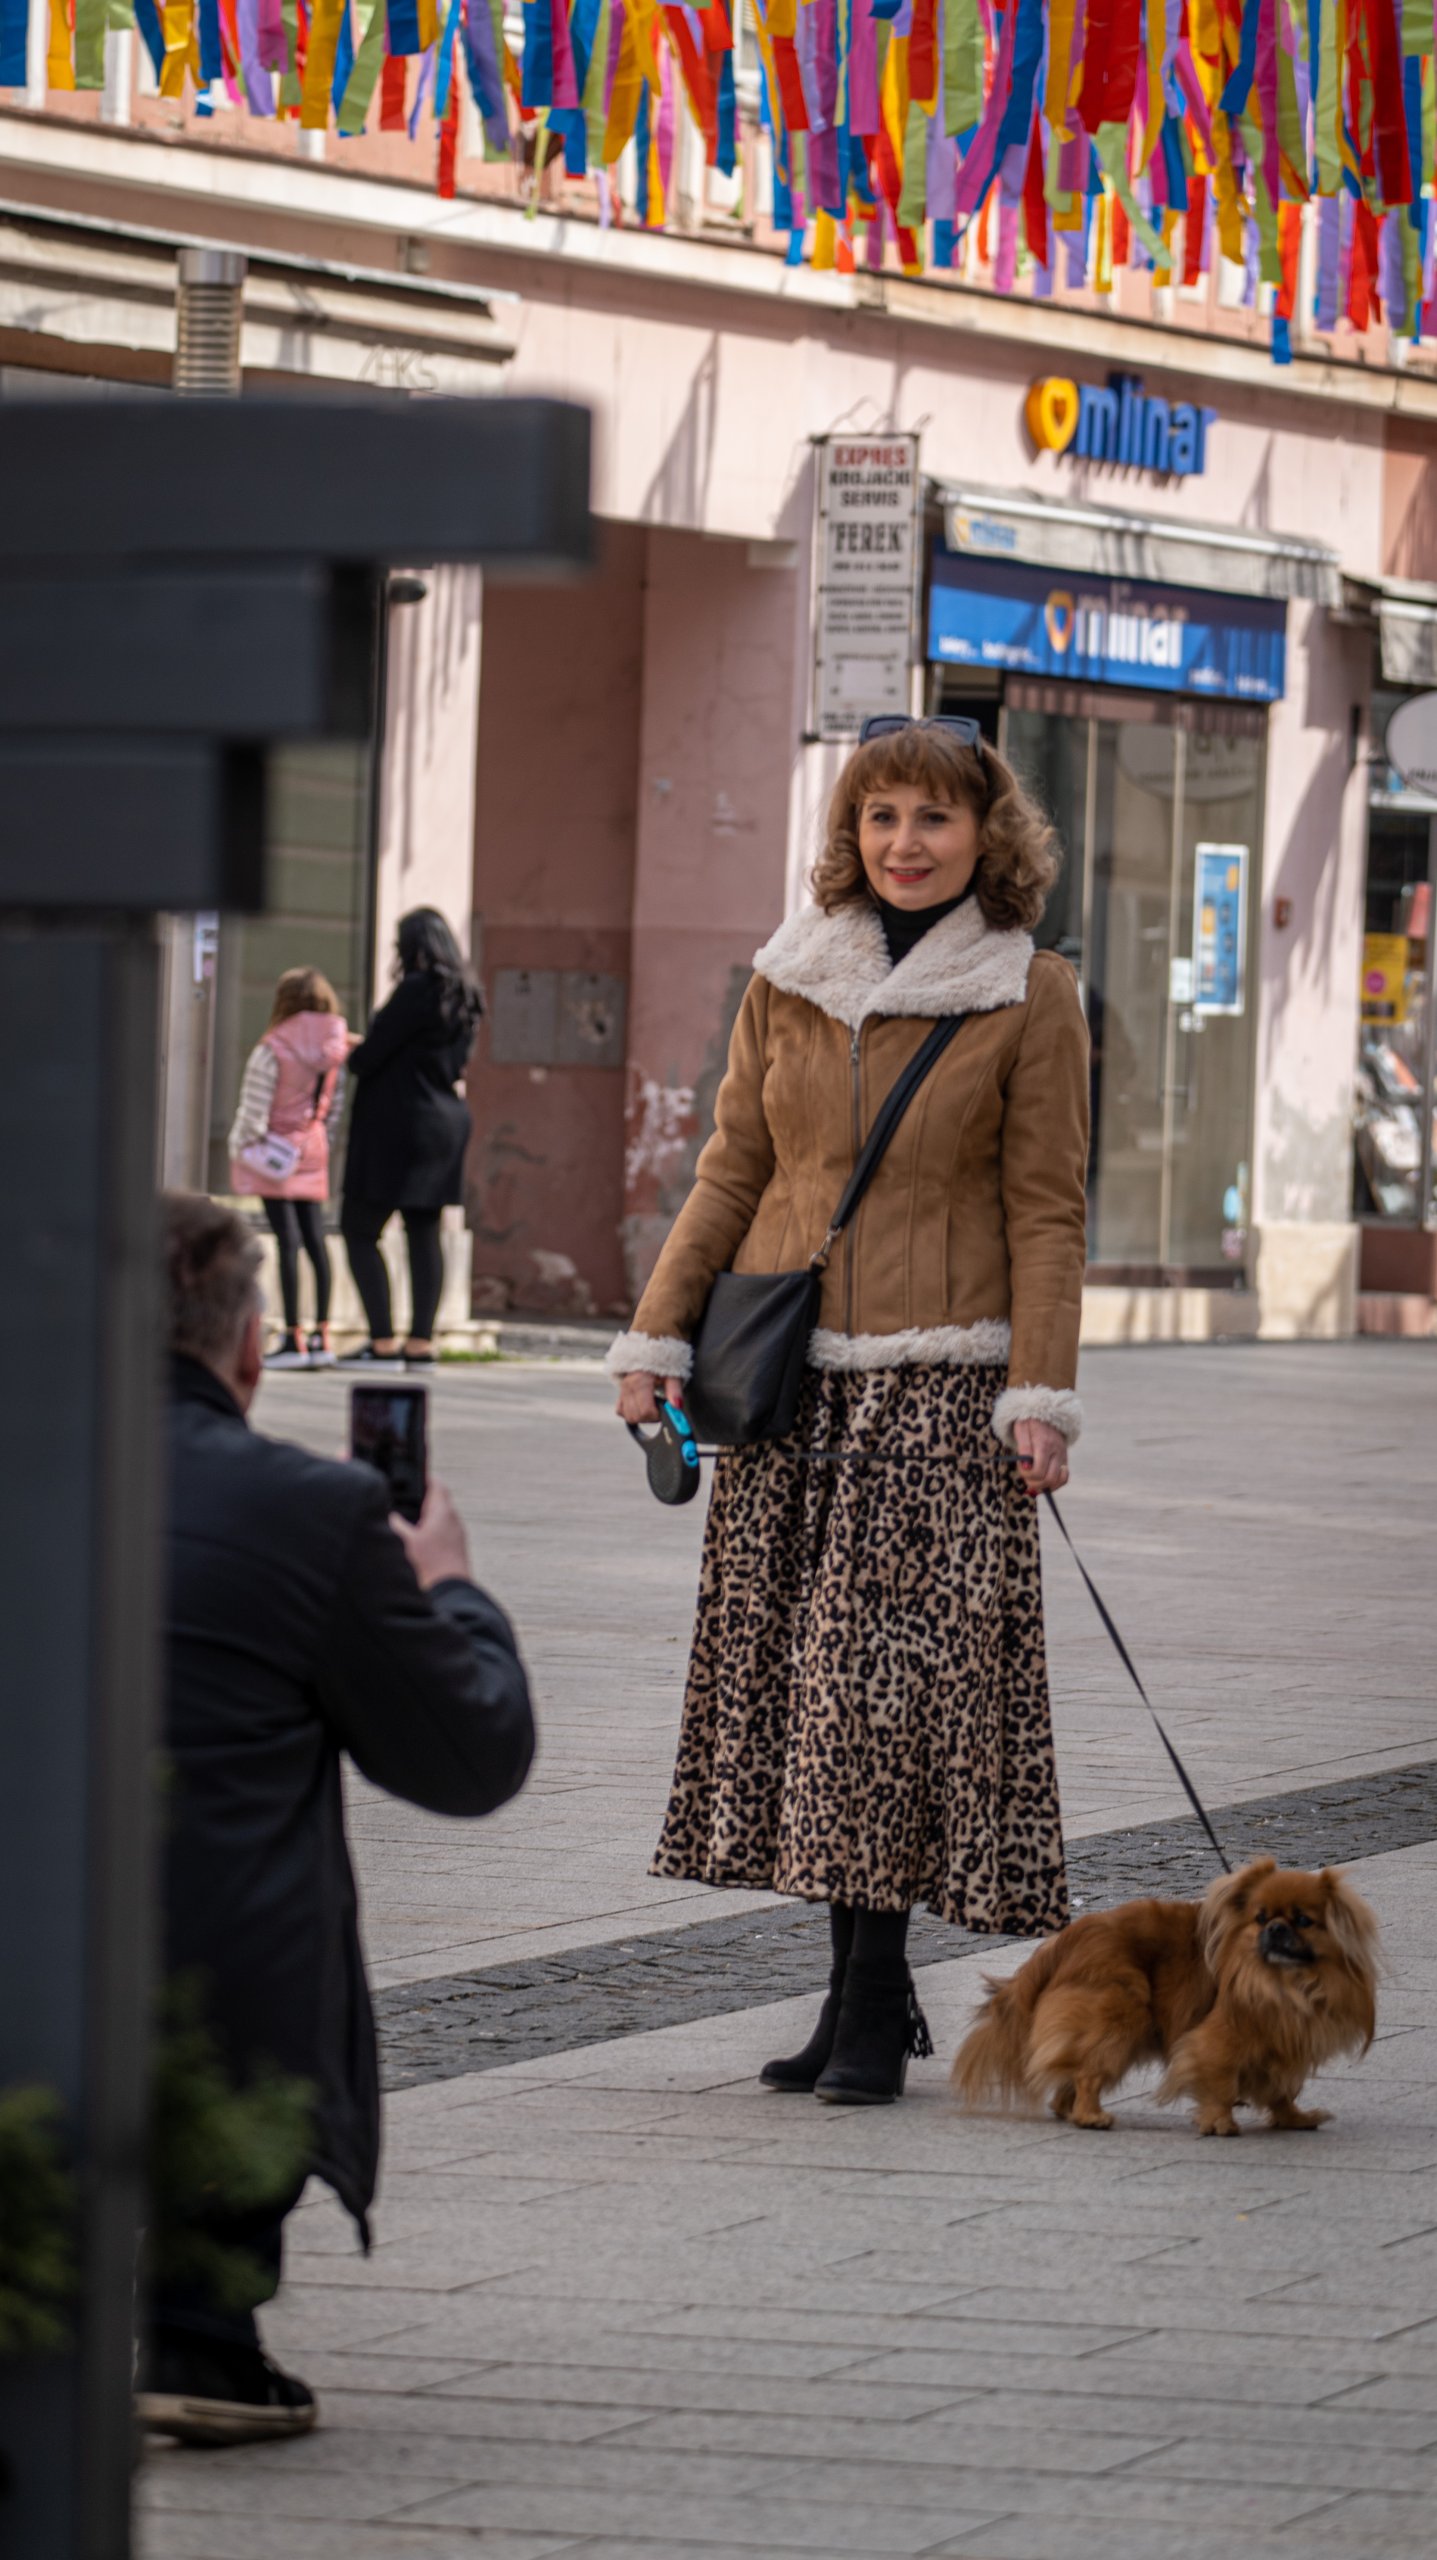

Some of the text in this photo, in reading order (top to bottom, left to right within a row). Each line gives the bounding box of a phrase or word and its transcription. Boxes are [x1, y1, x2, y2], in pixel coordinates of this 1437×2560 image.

[1076, 373, 1217, 475] mlinar
[834, 446, 906, 466] EXPRES
[841, 491, 899, 507] SERVIS
[1076, 583, 1188, 667] mlinar
